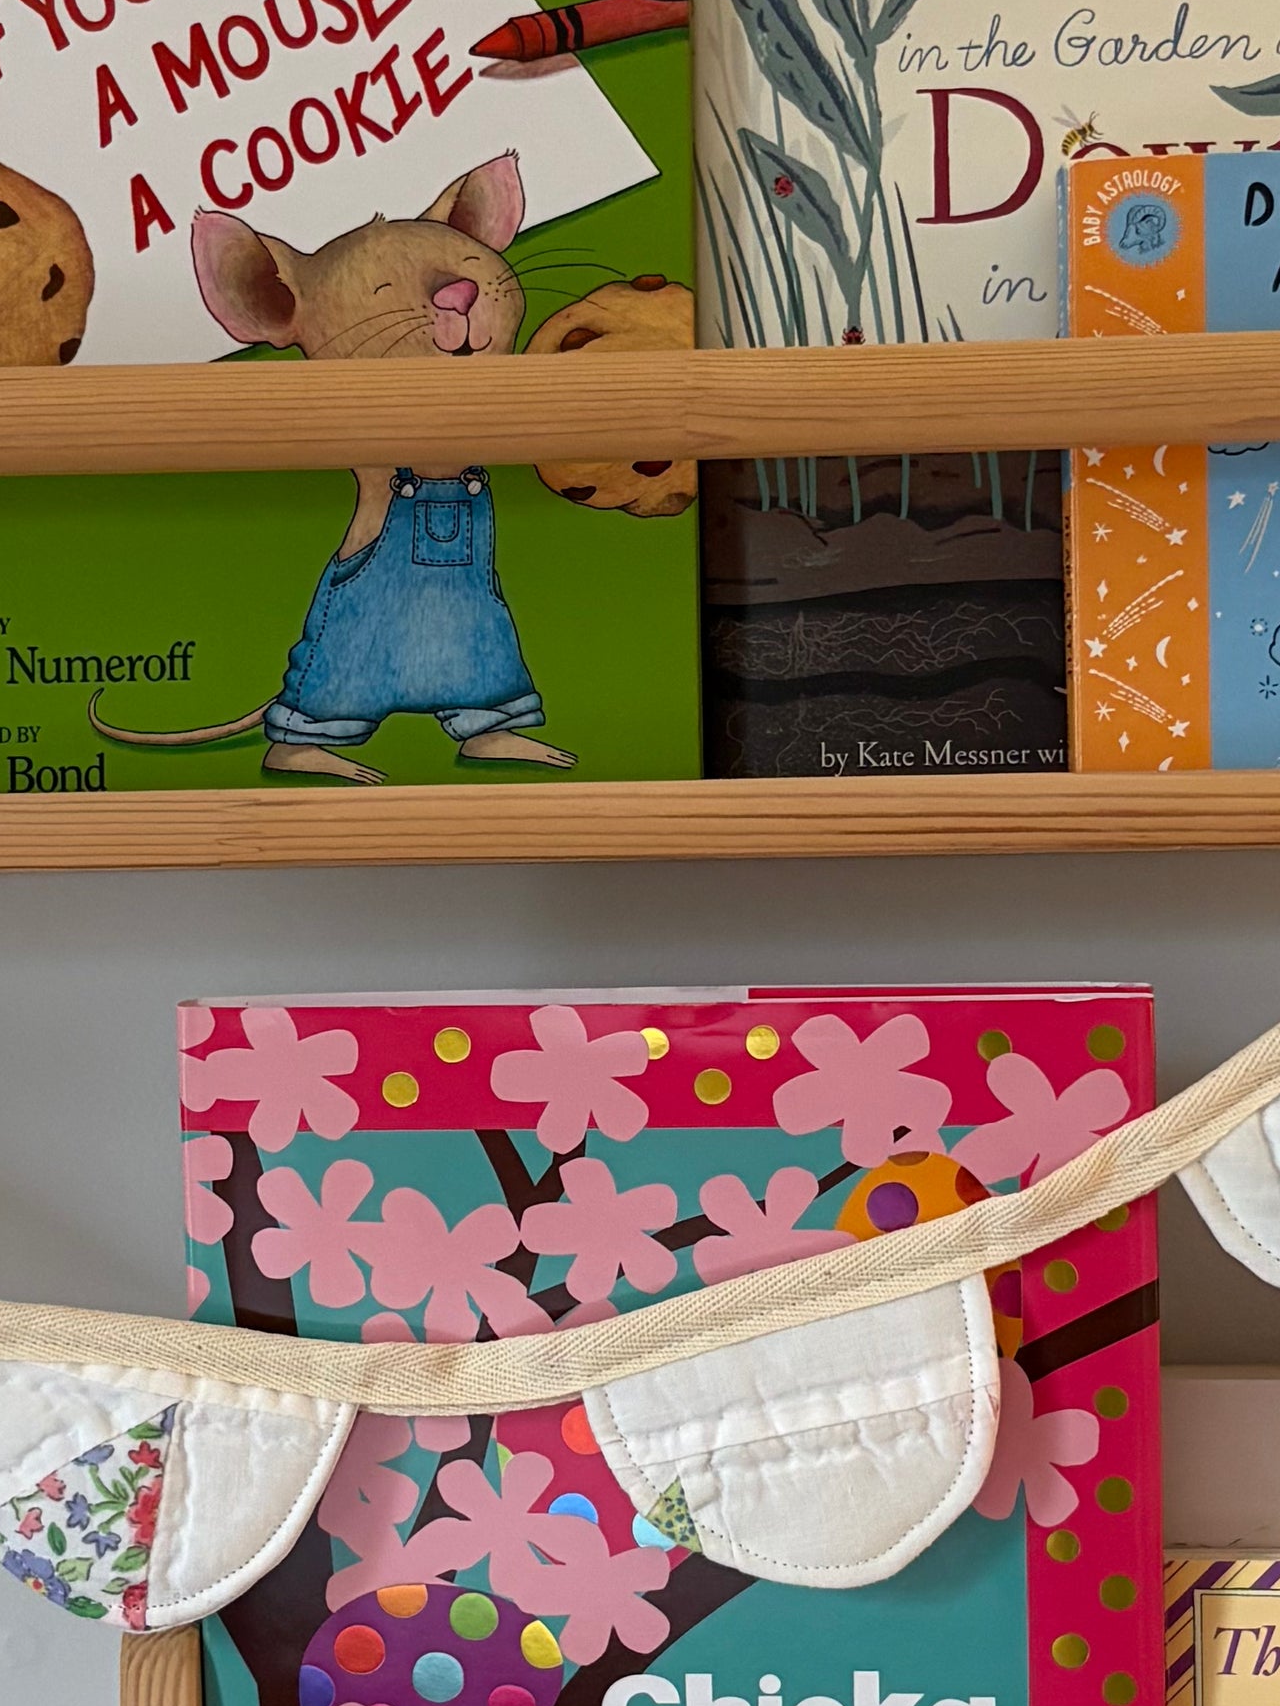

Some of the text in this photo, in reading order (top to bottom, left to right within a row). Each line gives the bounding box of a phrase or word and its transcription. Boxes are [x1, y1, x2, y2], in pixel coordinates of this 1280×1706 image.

[898, 32, 948, 72] in
[957, 14, 1036, 72] the
[1053, 2, 1261, 67] Garden
[95, 64, 138, 147] A
[130, 27, 474, 252] A COOKIE
[1082, 169, 1181, 246] BABY ASTROLOGY
[982, 264, 1048, 305] in
[6, 640, 196, 685] Numeroff
[17, 725, 41, 744] BY
[7, 752, 107, 794] Bond
[820, 741, 849, 777] by
[857, 741, 915, 768] Kate
[923, 740, 1030, 767] Messner
